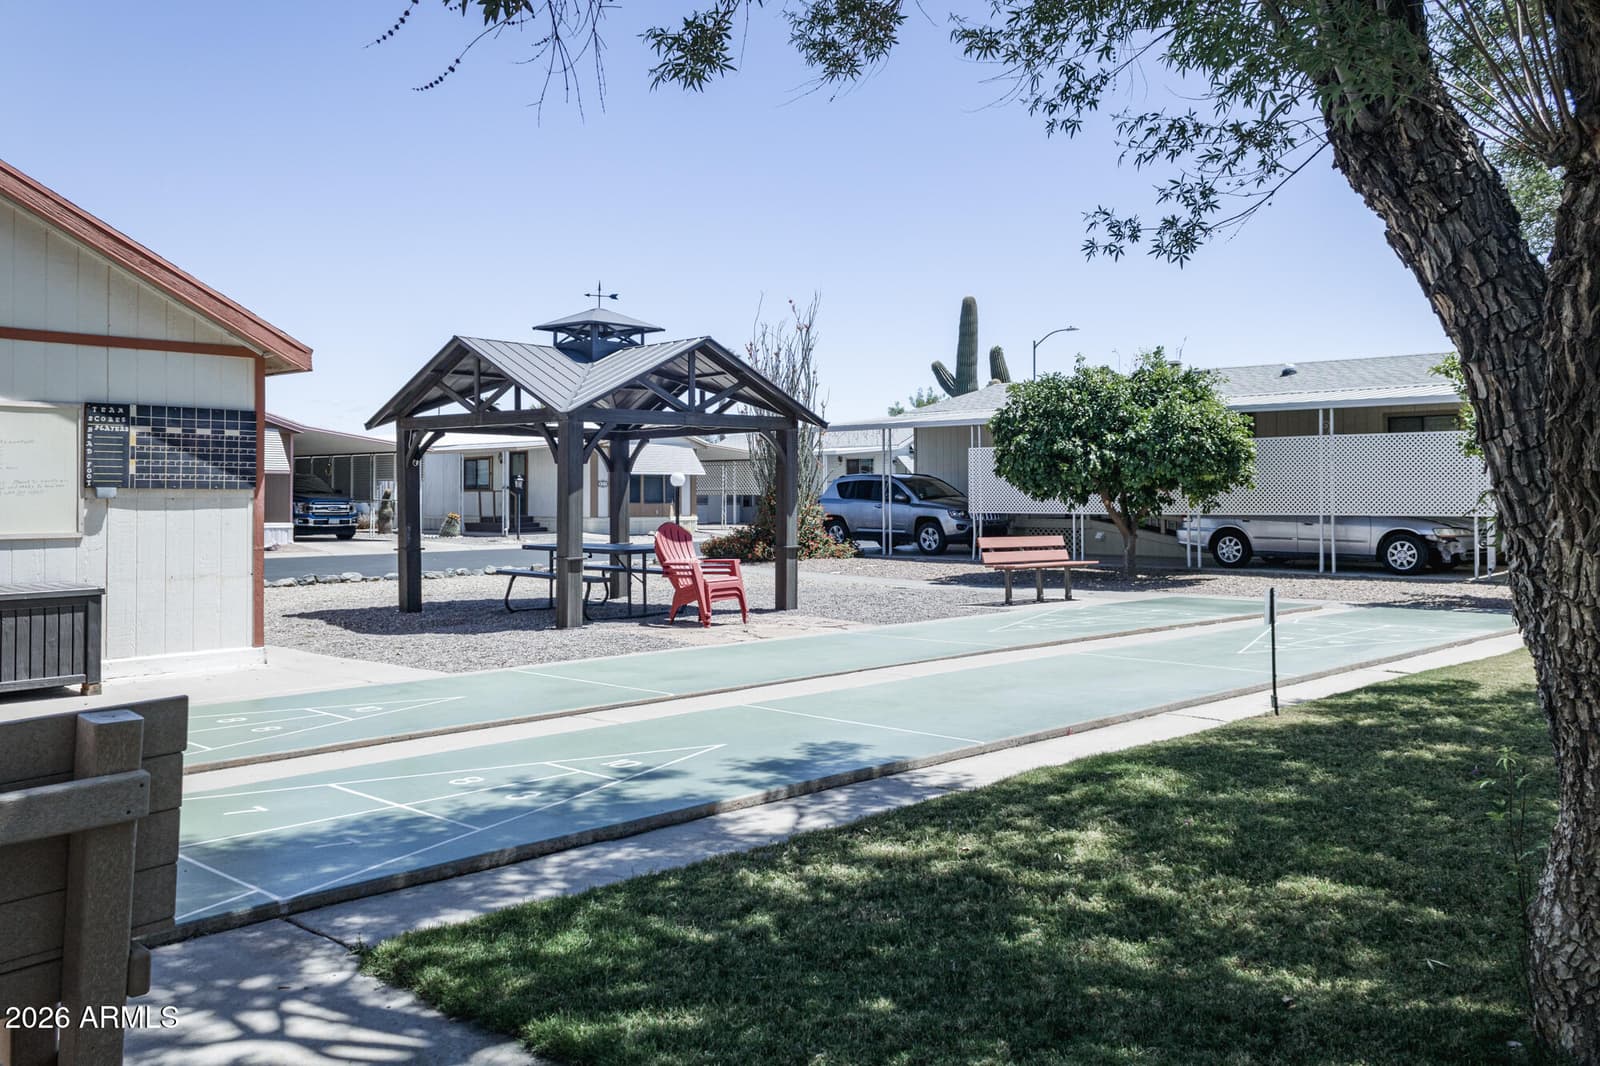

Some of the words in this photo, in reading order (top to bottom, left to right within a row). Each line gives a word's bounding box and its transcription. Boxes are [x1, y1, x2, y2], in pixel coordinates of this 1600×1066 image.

[92, 406, 124, 414] TEAM
[88, 415, 126, 423] SCORES
[448, 776, 485, 785] 8
